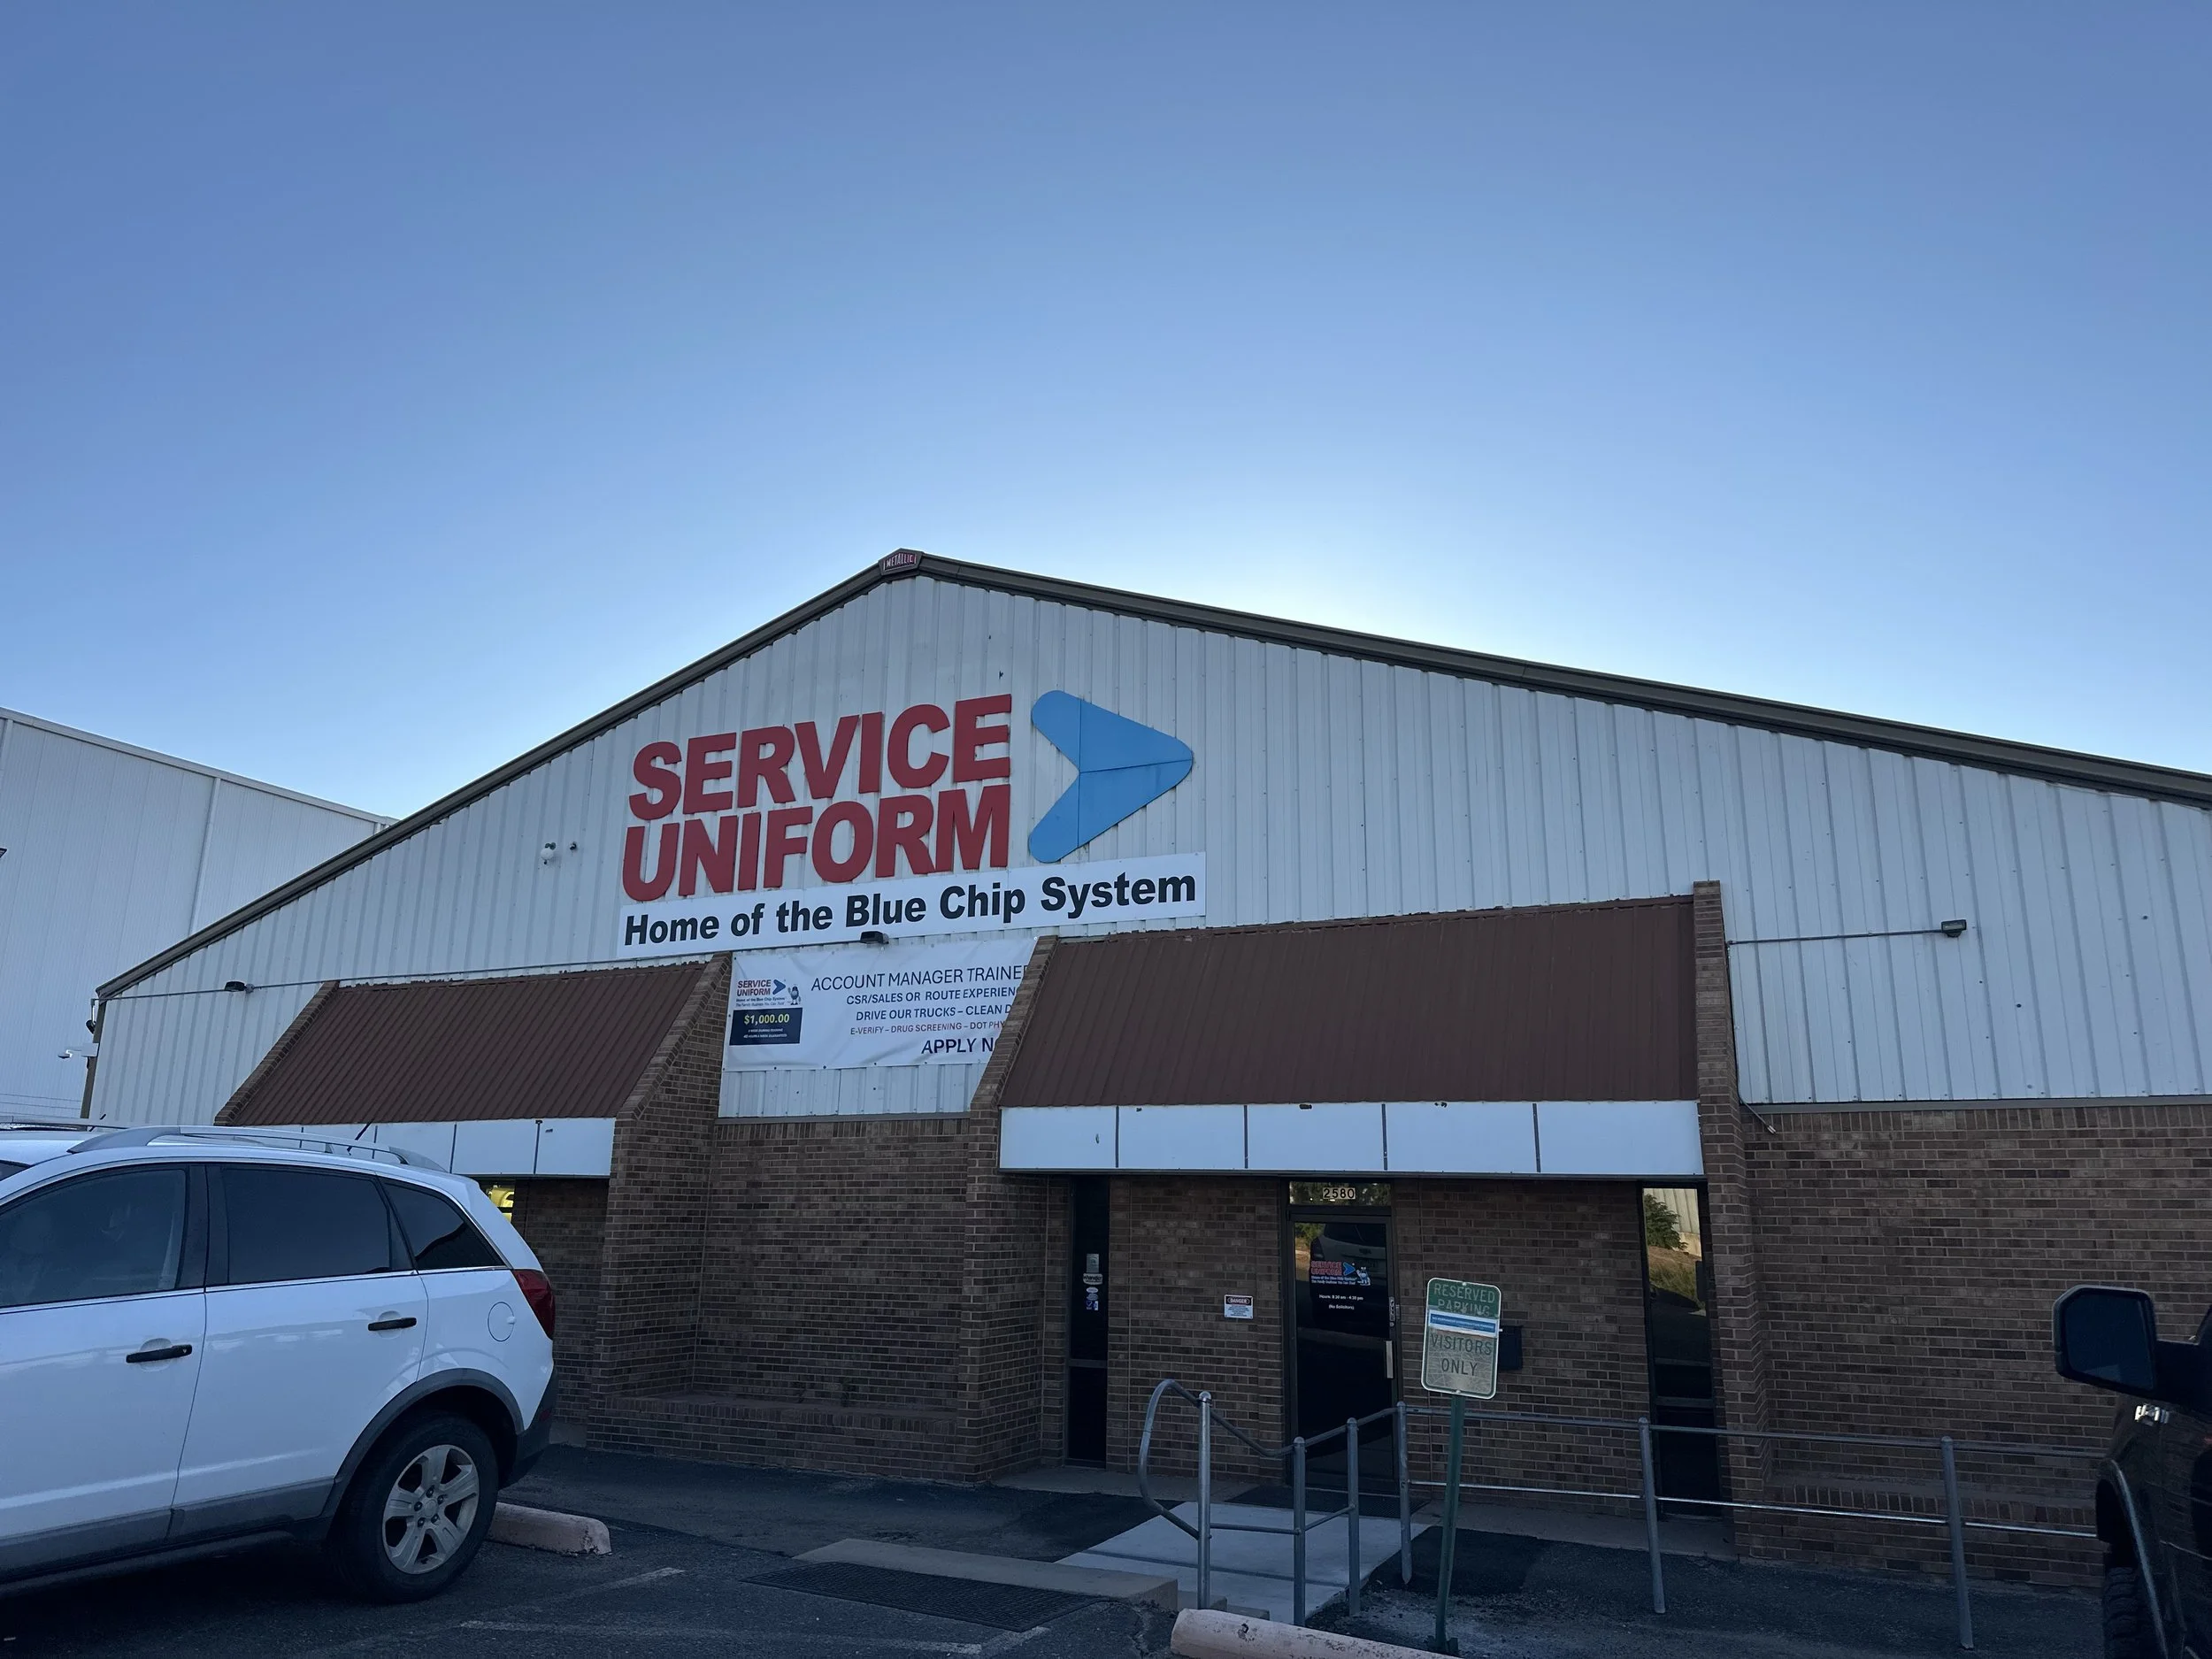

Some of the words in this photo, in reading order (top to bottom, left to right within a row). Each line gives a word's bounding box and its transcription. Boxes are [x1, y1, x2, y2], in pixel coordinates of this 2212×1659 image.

[628, 693, 1013, 821] SERVICE
[622, 784, 1011, 902] UNIFORM
[625, 913, 719, 946] Home
[730, 902, 765, 938] of
[775, 899, 833, 933] the
[845, 893, 927, 928] Blue
[939, 881, 1026, 924] Chip
[1041, 872, 1196, 918] System
[738, 979, 772, 988] SERVICE
[810, 973, 886, 991] ACCOUNT
[887, 968, 964, 987] MANAGER
[846, 993, 903, 1005] CSR/SALES
[905, 991, 921, 1002] OR
[925, 989, 961, 1001] ROUTE
[744, 1014, 790, 1025] $1,000.00
[856, 1010, 887, 1021] DRIVE
[889, 1009, 912, 1019] OUR
[913, 1006, 956, 1018] TRUCKS
[965, 1004, 1002, 1016] CLEAN
[850, 1025, 885, 1035] E-VERIFY
[891, 1025, 914, 1033] DRUG
[915, 1022, 963, 1032] SCREENING
[970, 1021, 987, 1030] DOT
[921, 1038, 977, 1054] APPLY
[1324, 1188, 1355, 1199] 2580
[1433, 1283, 1495, 1303] RESERVED
[1437, 1299, 1491, 1317] PARKING
[1431, 1333, 1493, 1356] VISITORS
[1441, 1358, 1478, 1376] ONLY
